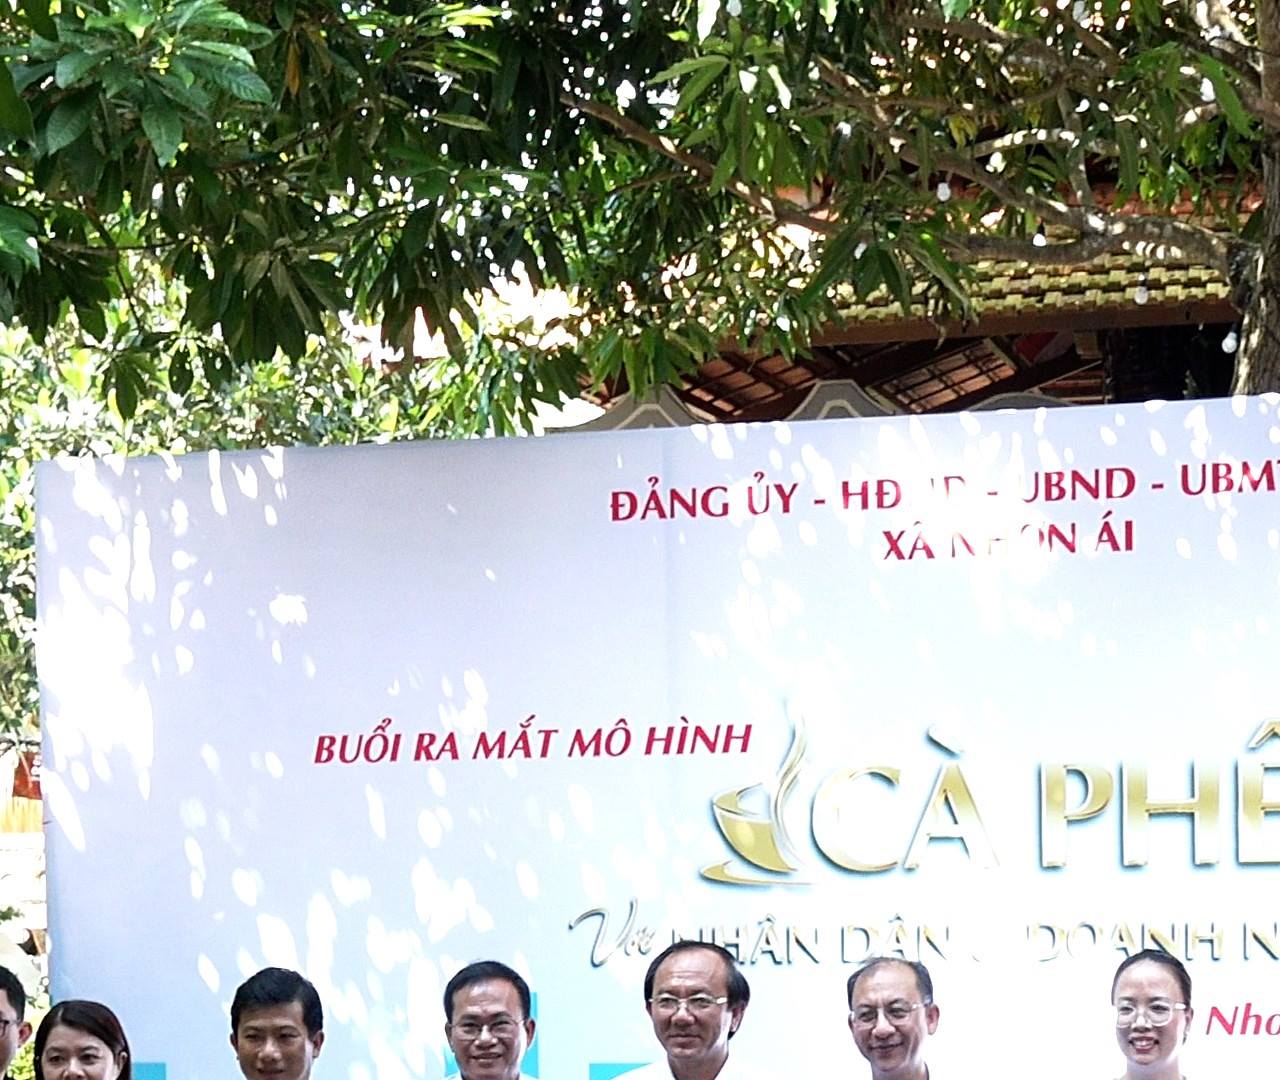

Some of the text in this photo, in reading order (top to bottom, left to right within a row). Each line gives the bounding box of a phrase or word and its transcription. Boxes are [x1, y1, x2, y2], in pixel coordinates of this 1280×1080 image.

[610, 476, 729, 521] ĐẢNG
[747, 471, 799, 515] ỦY
[1095, 510, 1133, 552] ÁI
[314, 714, 753, 763] BUỔI RA MẮT MÔ HÌNH
[810, 723, 1000, 874] CÀ
